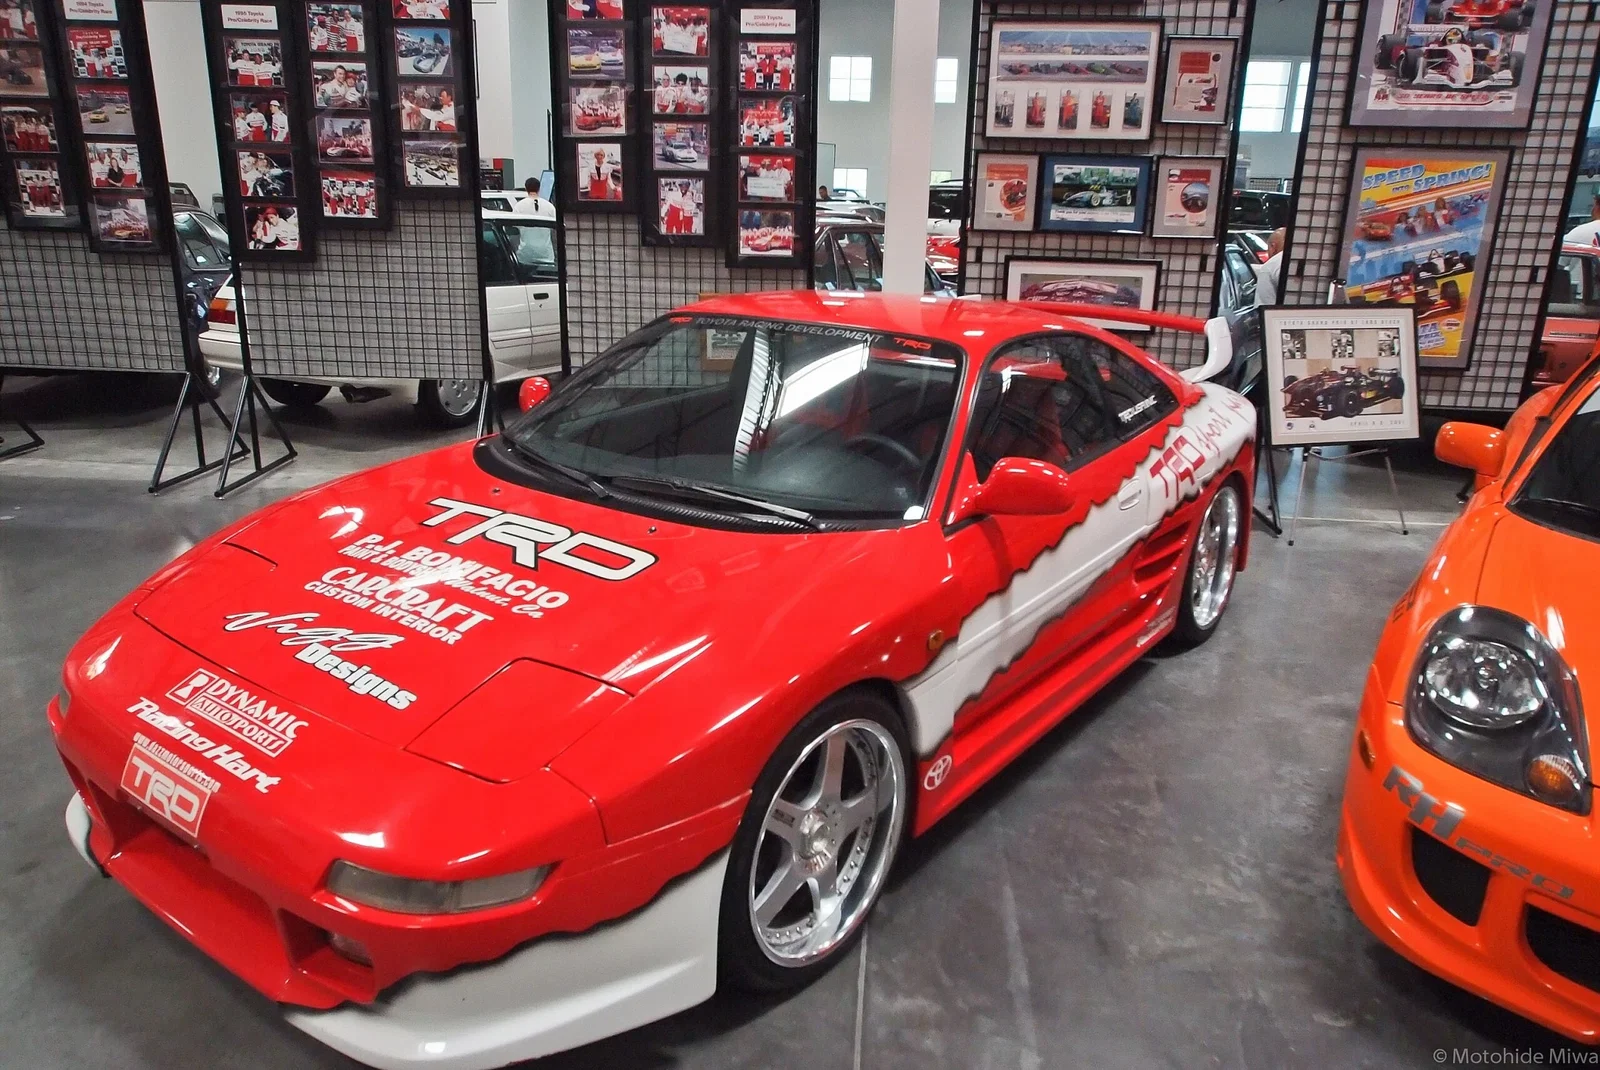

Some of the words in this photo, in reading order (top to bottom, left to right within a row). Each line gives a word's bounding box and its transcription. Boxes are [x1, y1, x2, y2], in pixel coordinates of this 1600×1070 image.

[1362, 164, 1426, 191] SPEED
[1413, 163, 1492, 194] SPRING!
[696, 317, 736, 326] TOYOTA
[740, 319, 782, 331] RACING
[784, 324, 884, 343] DEVELOPMENT
[894, 337, 932, 350] TRD
[337, 544, 373, 563] PAINT
[370, 553, 388, 564] &
[420, 497, 659, 581] TRD
[321, 566, 495, 633] CARCRAFT
[351, 533, 404, 555] P.J.
[400, 546, 570, 609] BONIFACIO
[304, 580, 376, 609] CUSTOM
[370, 602, 462, 646] INTERIOR
[293, 642, 418, 710] Designs
[191, 696, 285, 753] AUTOSPORTS
[205, 678, 309, 739] DYNAMIC
[131, 756, 201, 823] TRD
[1382, 763, 1467, 840] RH
[1455, 836, 1576, 900] PRO
